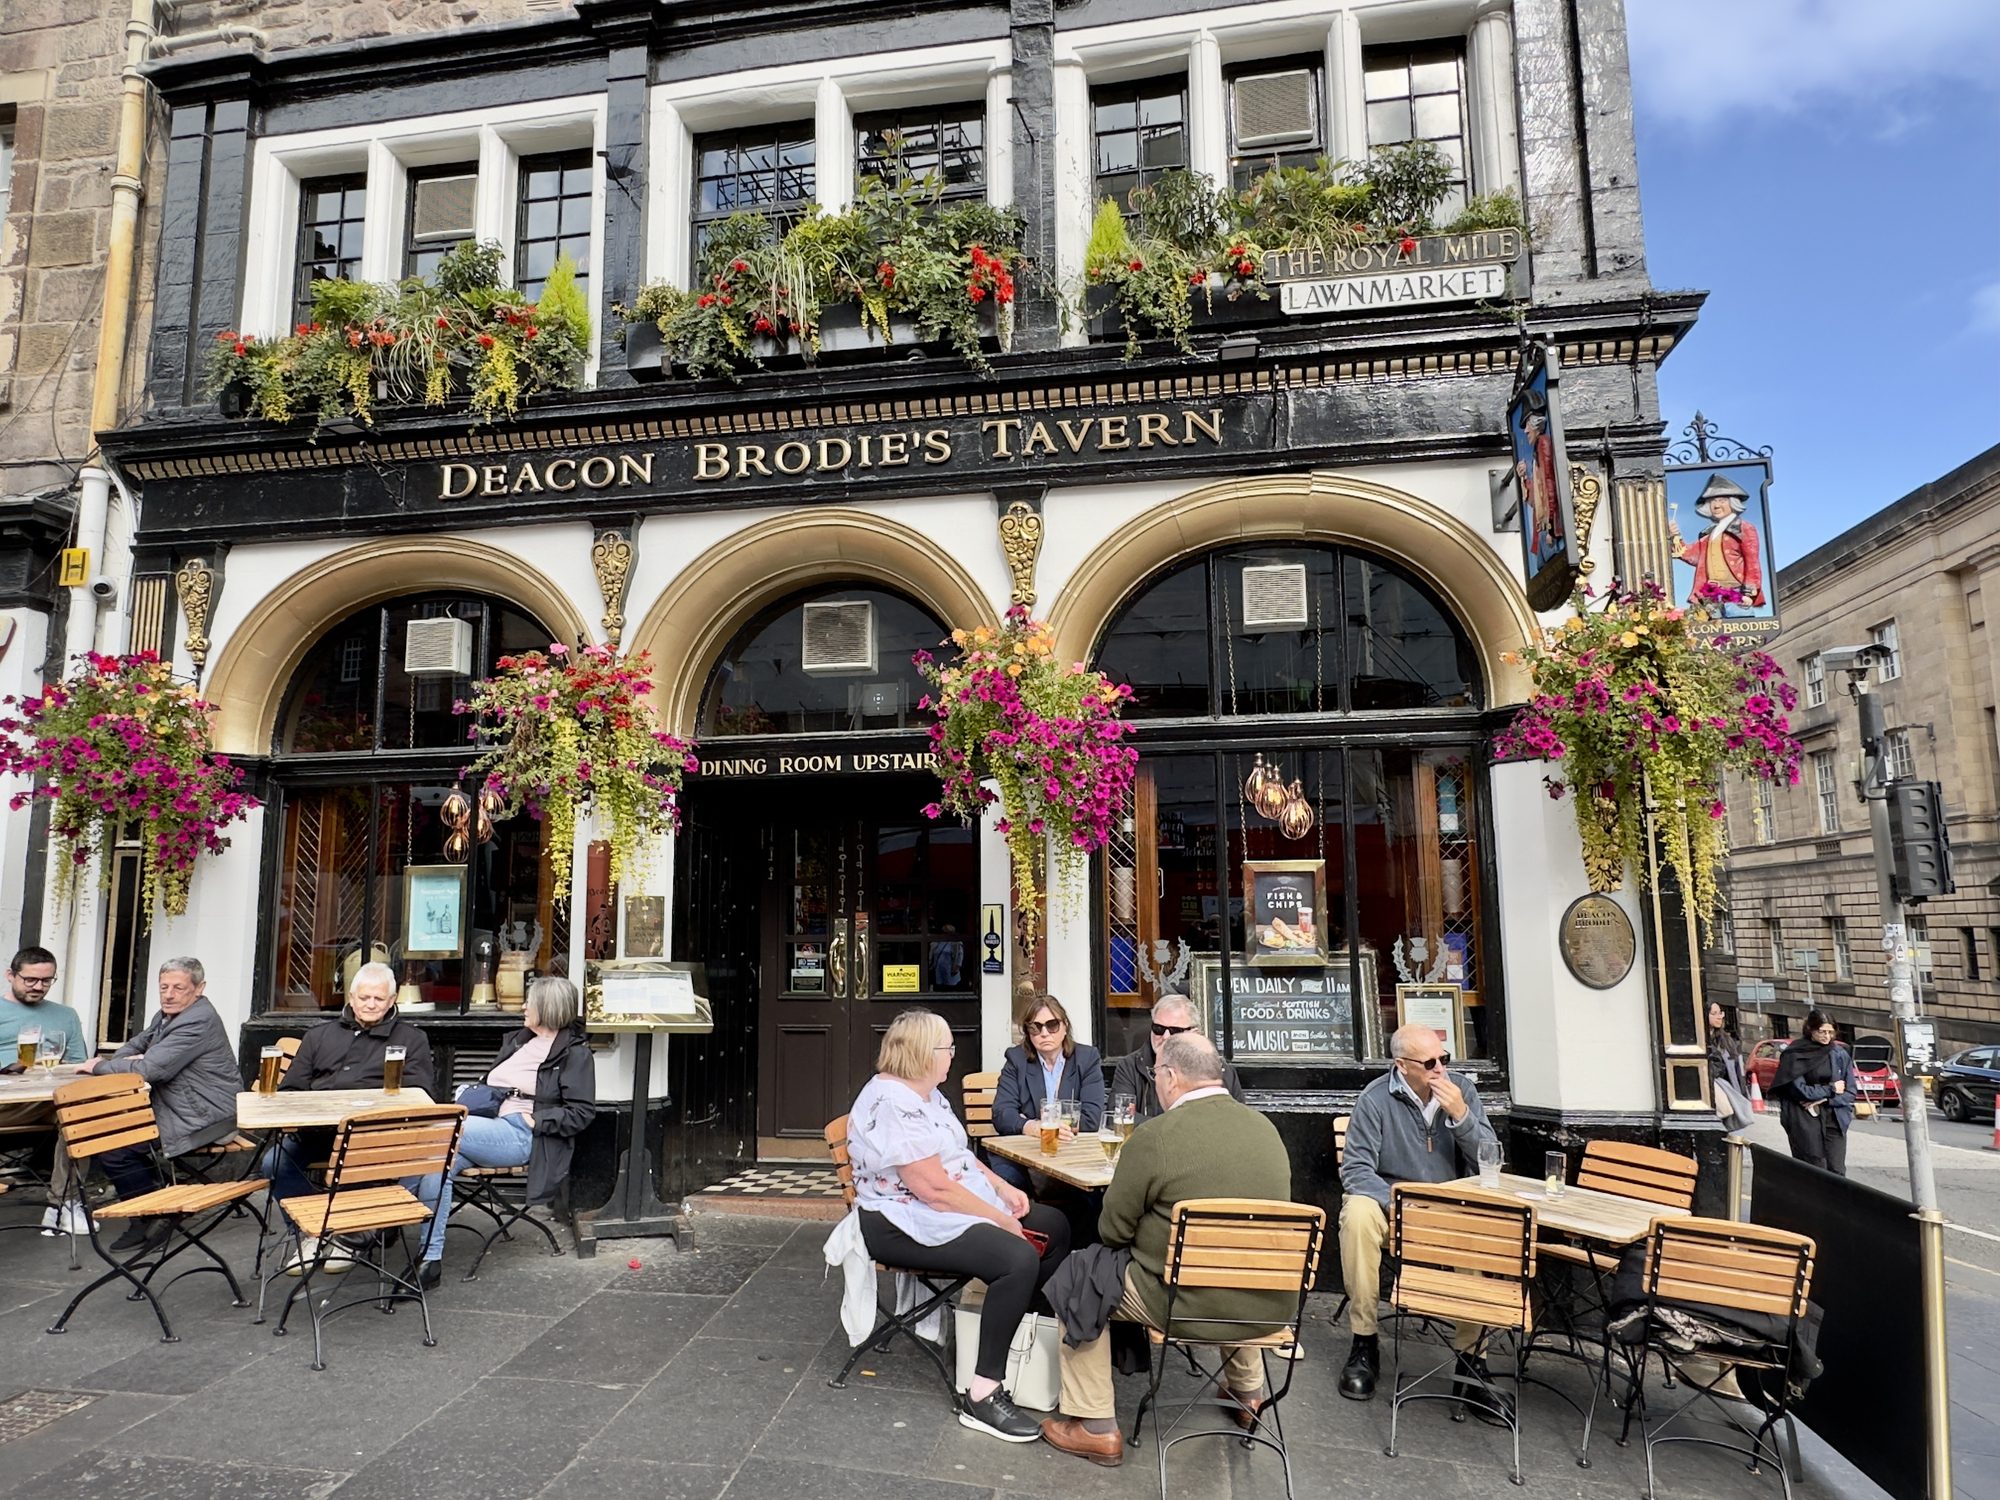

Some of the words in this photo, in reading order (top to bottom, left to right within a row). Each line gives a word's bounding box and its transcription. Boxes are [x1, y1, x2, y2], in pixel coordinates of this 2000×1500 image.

[1267, 250, 1321, 277] THE
[1334, 241, 1430, 273] ROYAL
[1443, 232, 1515, 263] MILE
[1288, 269, 1497, 310] LAWNMARKET
[438, 452, 655, 500] DEACON
[693, 428, 952, 481] BRODIE'S
[981, 408, 1224, 459] TAVERN
[1722, 620, 1780, 634] BRODIE'S
[701, 758, 767, 776] DINING
[779, 754, 842, 774] ROOM
[1266, 892, 1293, 900] FISH
[1296, 892, 1303, 900] &
[1267, 901, 1303, 909] CHIPS
[1216, 977, 1250, 994] OEN
[1255, 977, 1296, 994] DAILY
[1281, 1000, 1320, 1009] SCOTTISH
[1240, 1007, 1275, 1020] FOOD
[1275, 1010, 1284, 1020] &
[1286, 1007, 1331, 1020] DRINKS
[1247, 1030, 1290, 1052] MUSIC
